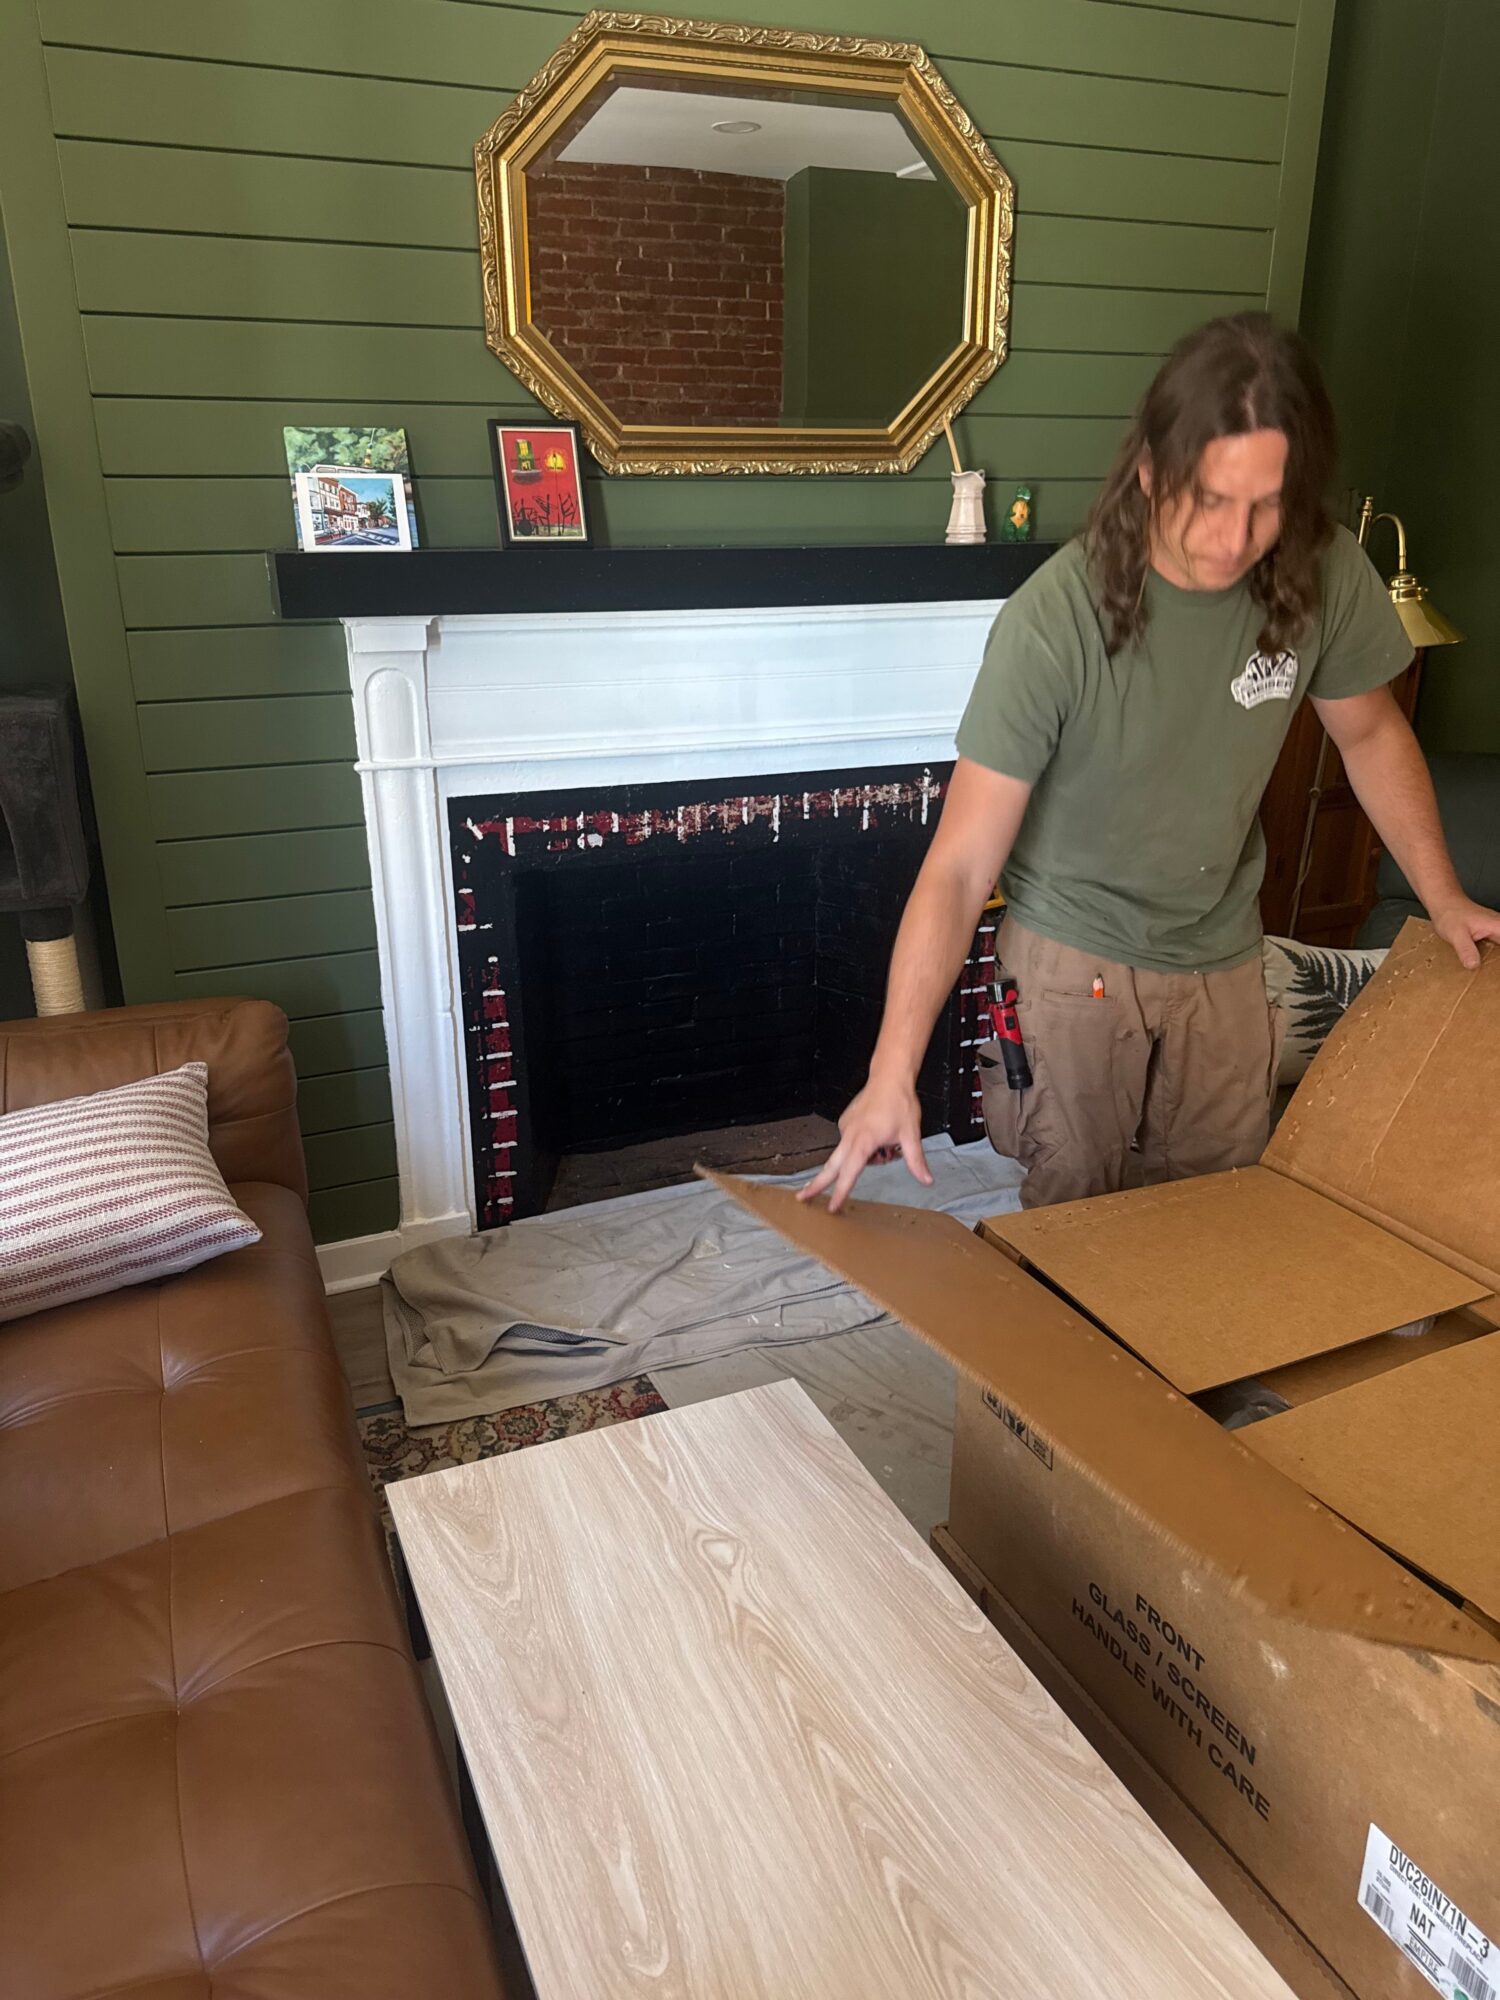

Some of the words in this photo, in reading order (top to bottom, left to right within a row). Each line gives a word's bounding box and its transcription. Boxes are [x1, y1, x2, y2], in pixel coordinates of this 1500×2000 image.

[1136, 1593, 1205, 1672] FRONT
[1072, 1598, 1146, 1688] HANDLE
[1152, 1679, 1202, 1748] WITH
[1208, 1744, 1271, 1822] CARE
[1089, 1583, 1151, 1656] GLASS
[1167, 1662, 1256, 1766] SCREEN
[1408, 1935, 1439, 1976] EMPIRE
[1410, 1902, 1435, 1939] NAT
